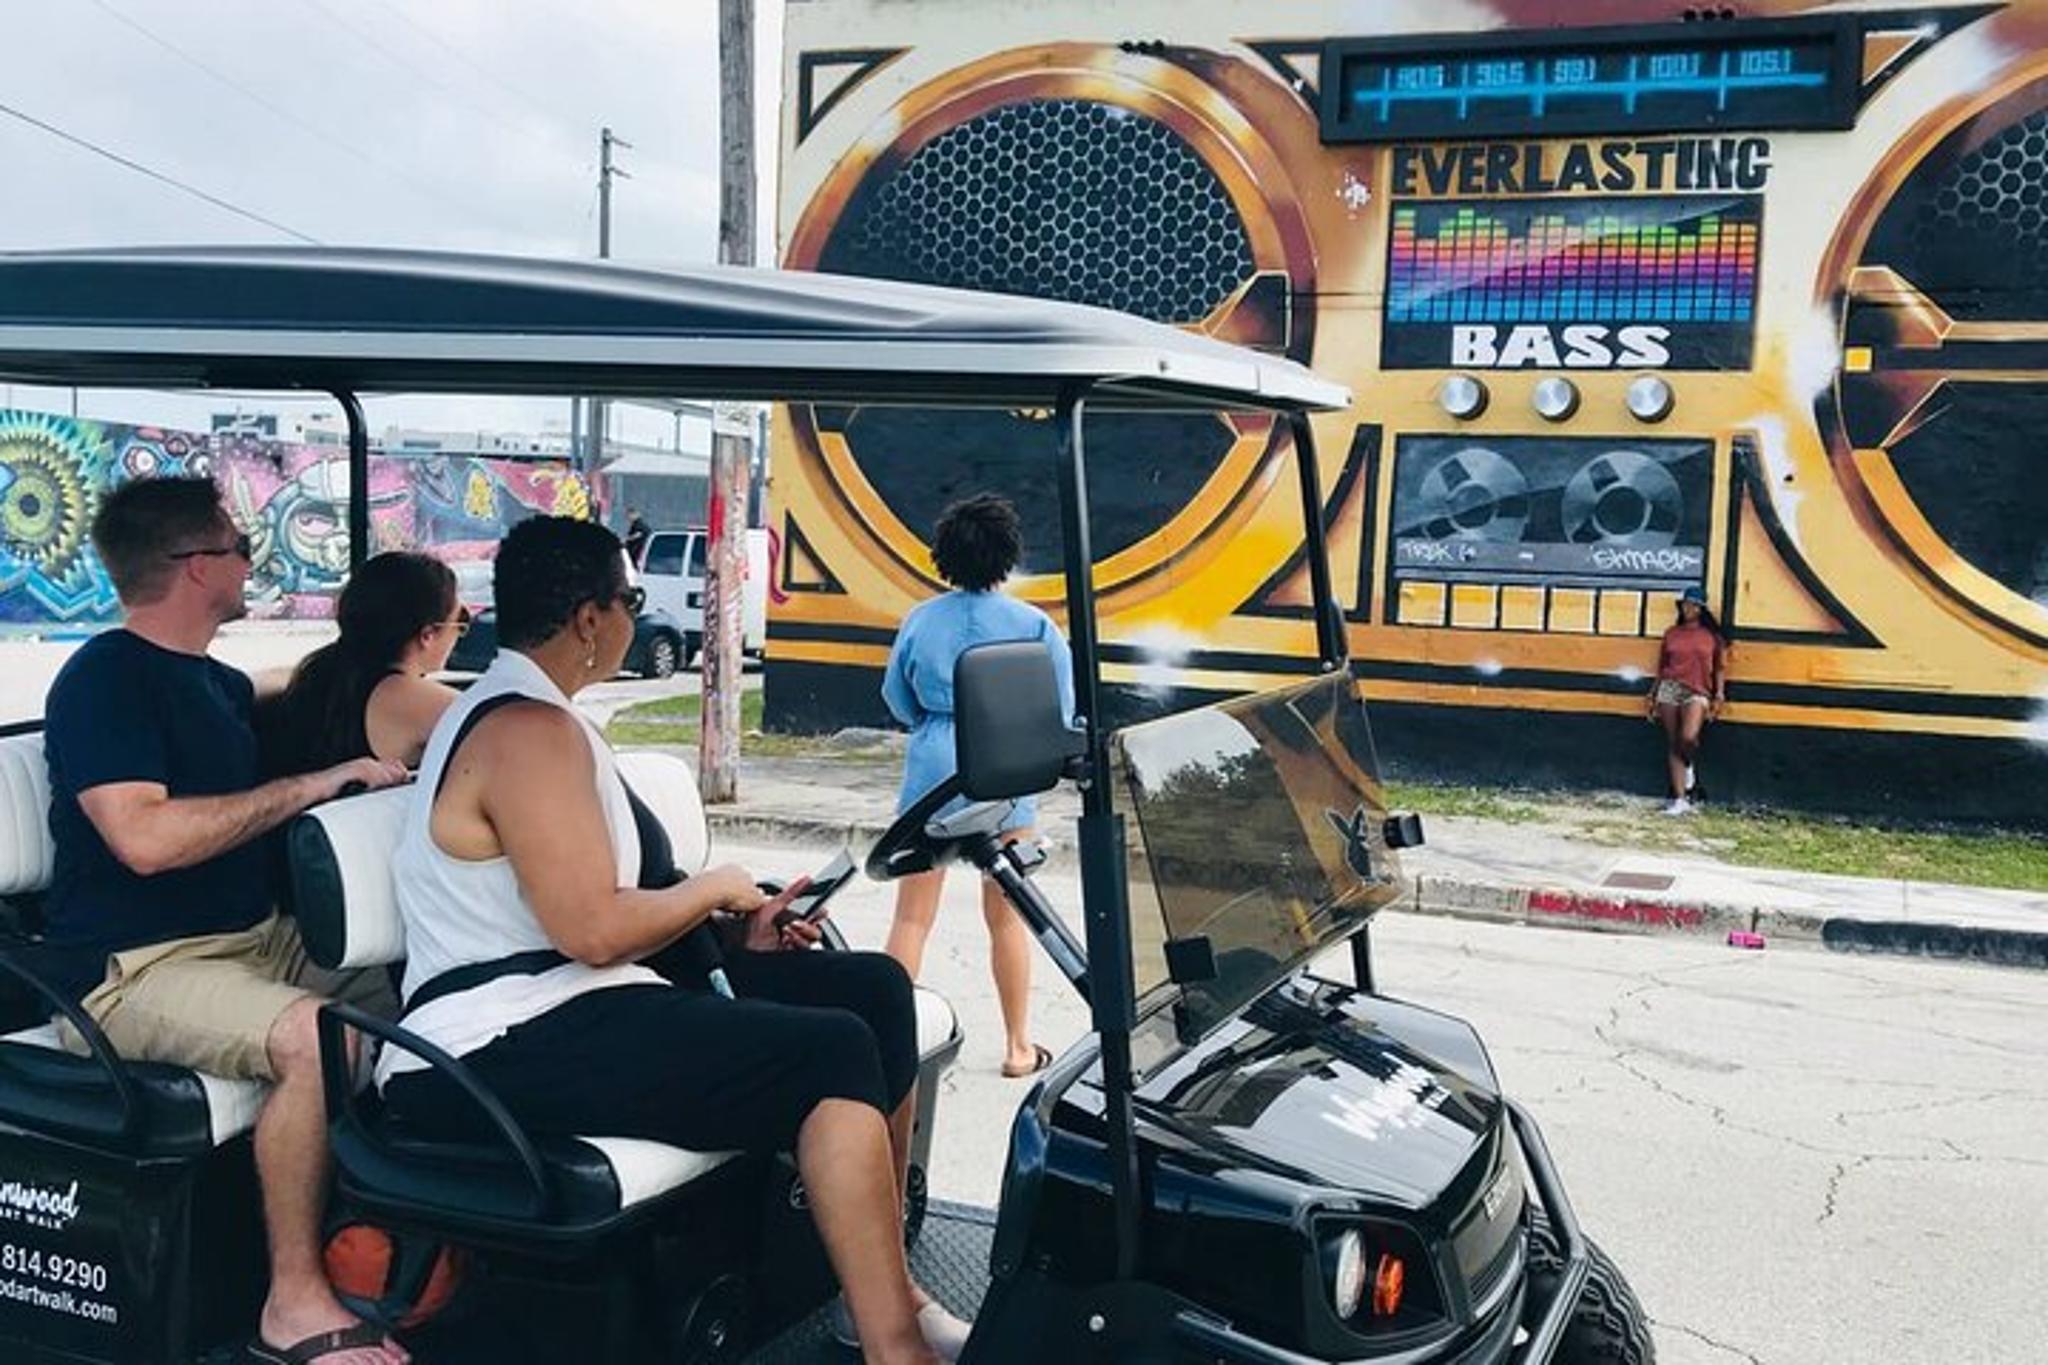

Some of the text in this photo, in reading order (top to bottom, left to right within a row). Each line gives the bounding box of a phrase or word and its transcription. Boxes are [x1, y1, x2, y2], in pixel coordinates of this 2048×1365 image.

[1391, 138, 1772, 195] EVERLASTING
[1451, 325, 1671, 367] BASS
[0, 1180, 79, 1219] nwood
[2, 1244, 106, 1292] 814.9290
